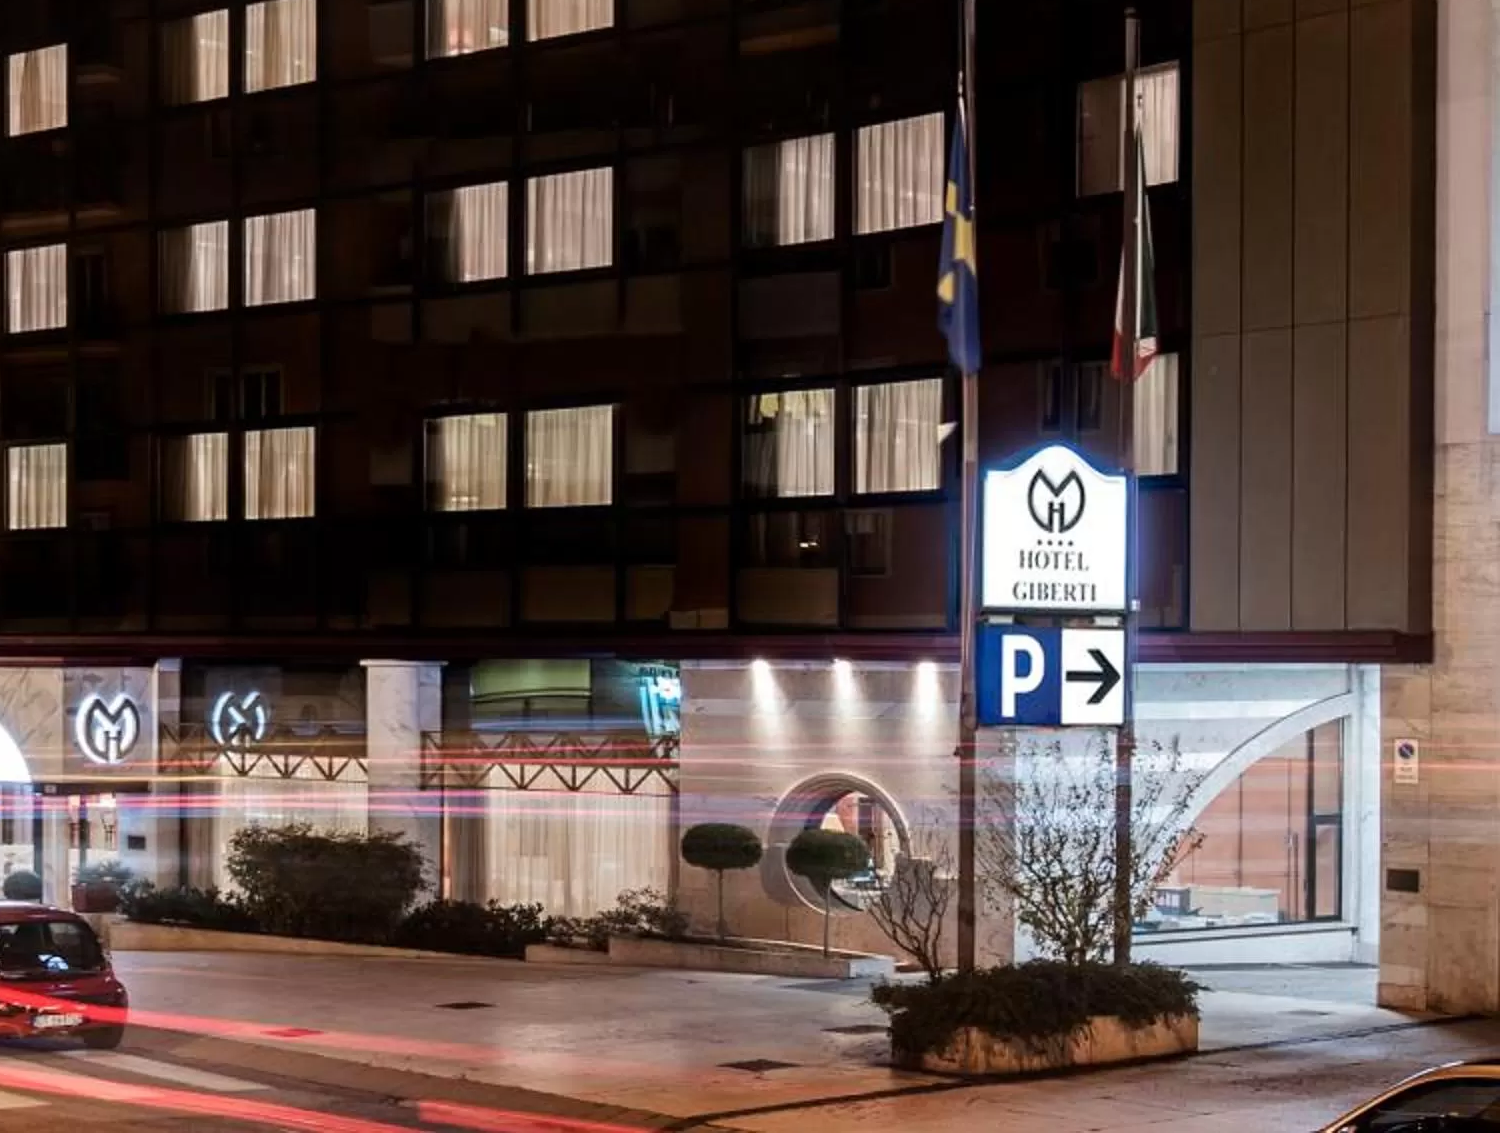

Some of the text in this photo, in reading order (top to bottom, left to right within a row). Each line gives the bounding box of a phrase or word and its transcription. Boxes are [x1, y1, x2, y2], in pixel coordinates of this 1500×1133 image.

[1018, 549, 1090, 571] HOTEL
[1012, 582, 1098, 602] GIBERTI
[1001, 634, 1046, 718] P
